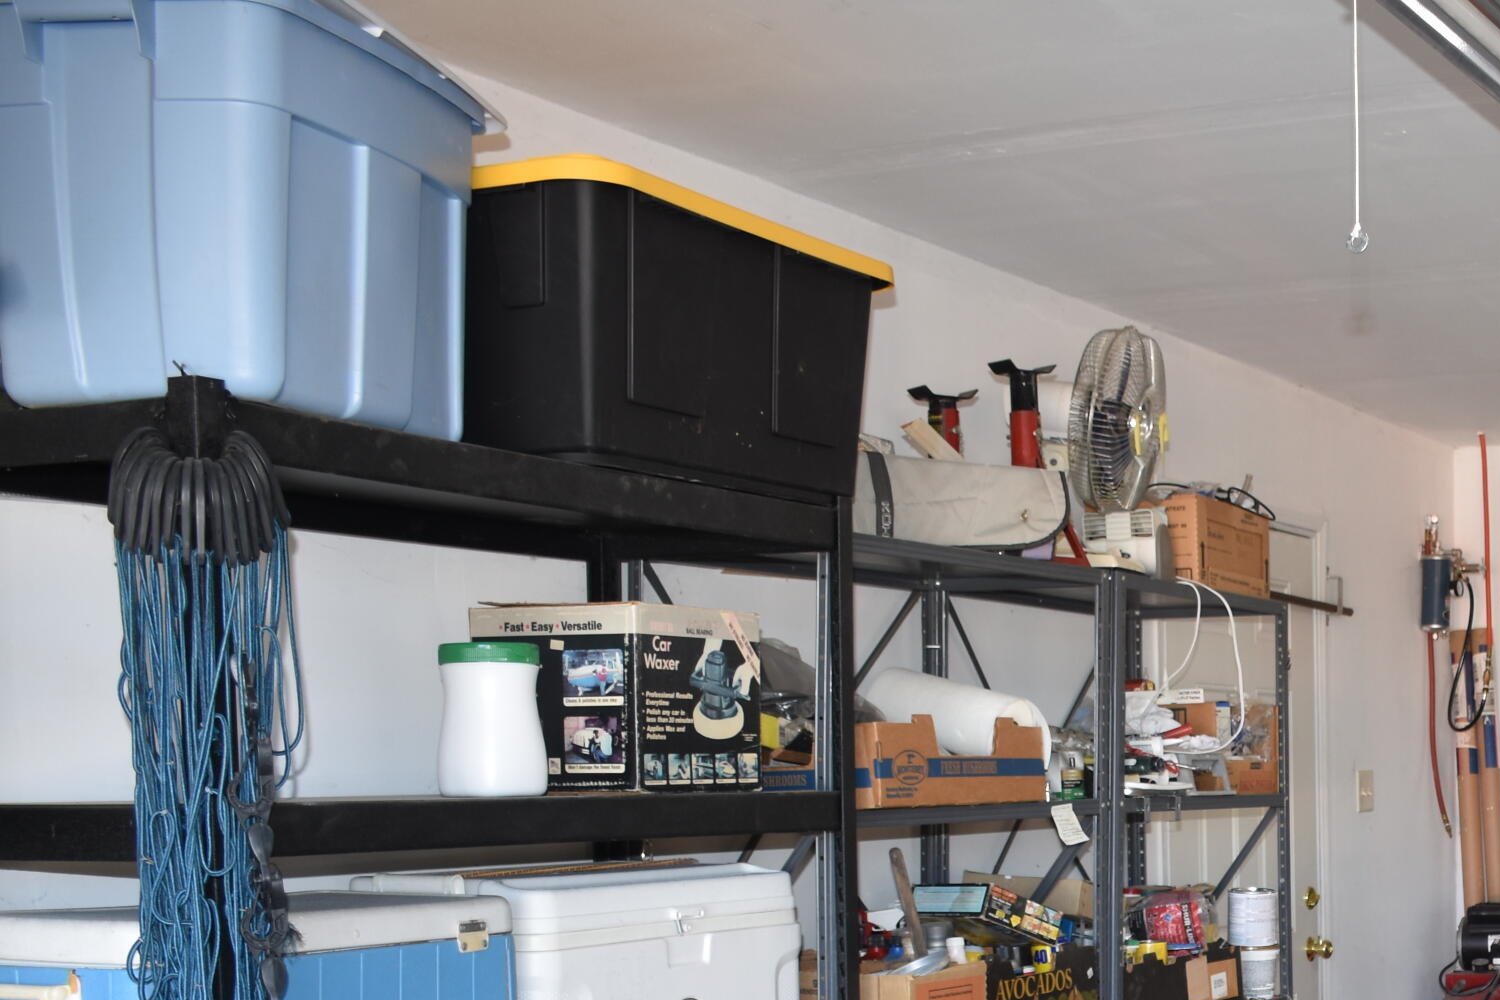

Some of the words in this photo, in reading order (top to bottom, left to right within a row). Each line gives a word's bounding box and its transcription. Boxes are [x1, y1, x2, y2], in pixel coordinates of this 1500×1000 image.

[504, 622, 524, 632] Fast
[531, 622, 553, 633] Easy
[561, 621, 602, 631] Versatile
[652, 636, 672, 652] Car
[644, 653, 680, 671] Waxer
[763, 775, 807, 787] SHROOMS
